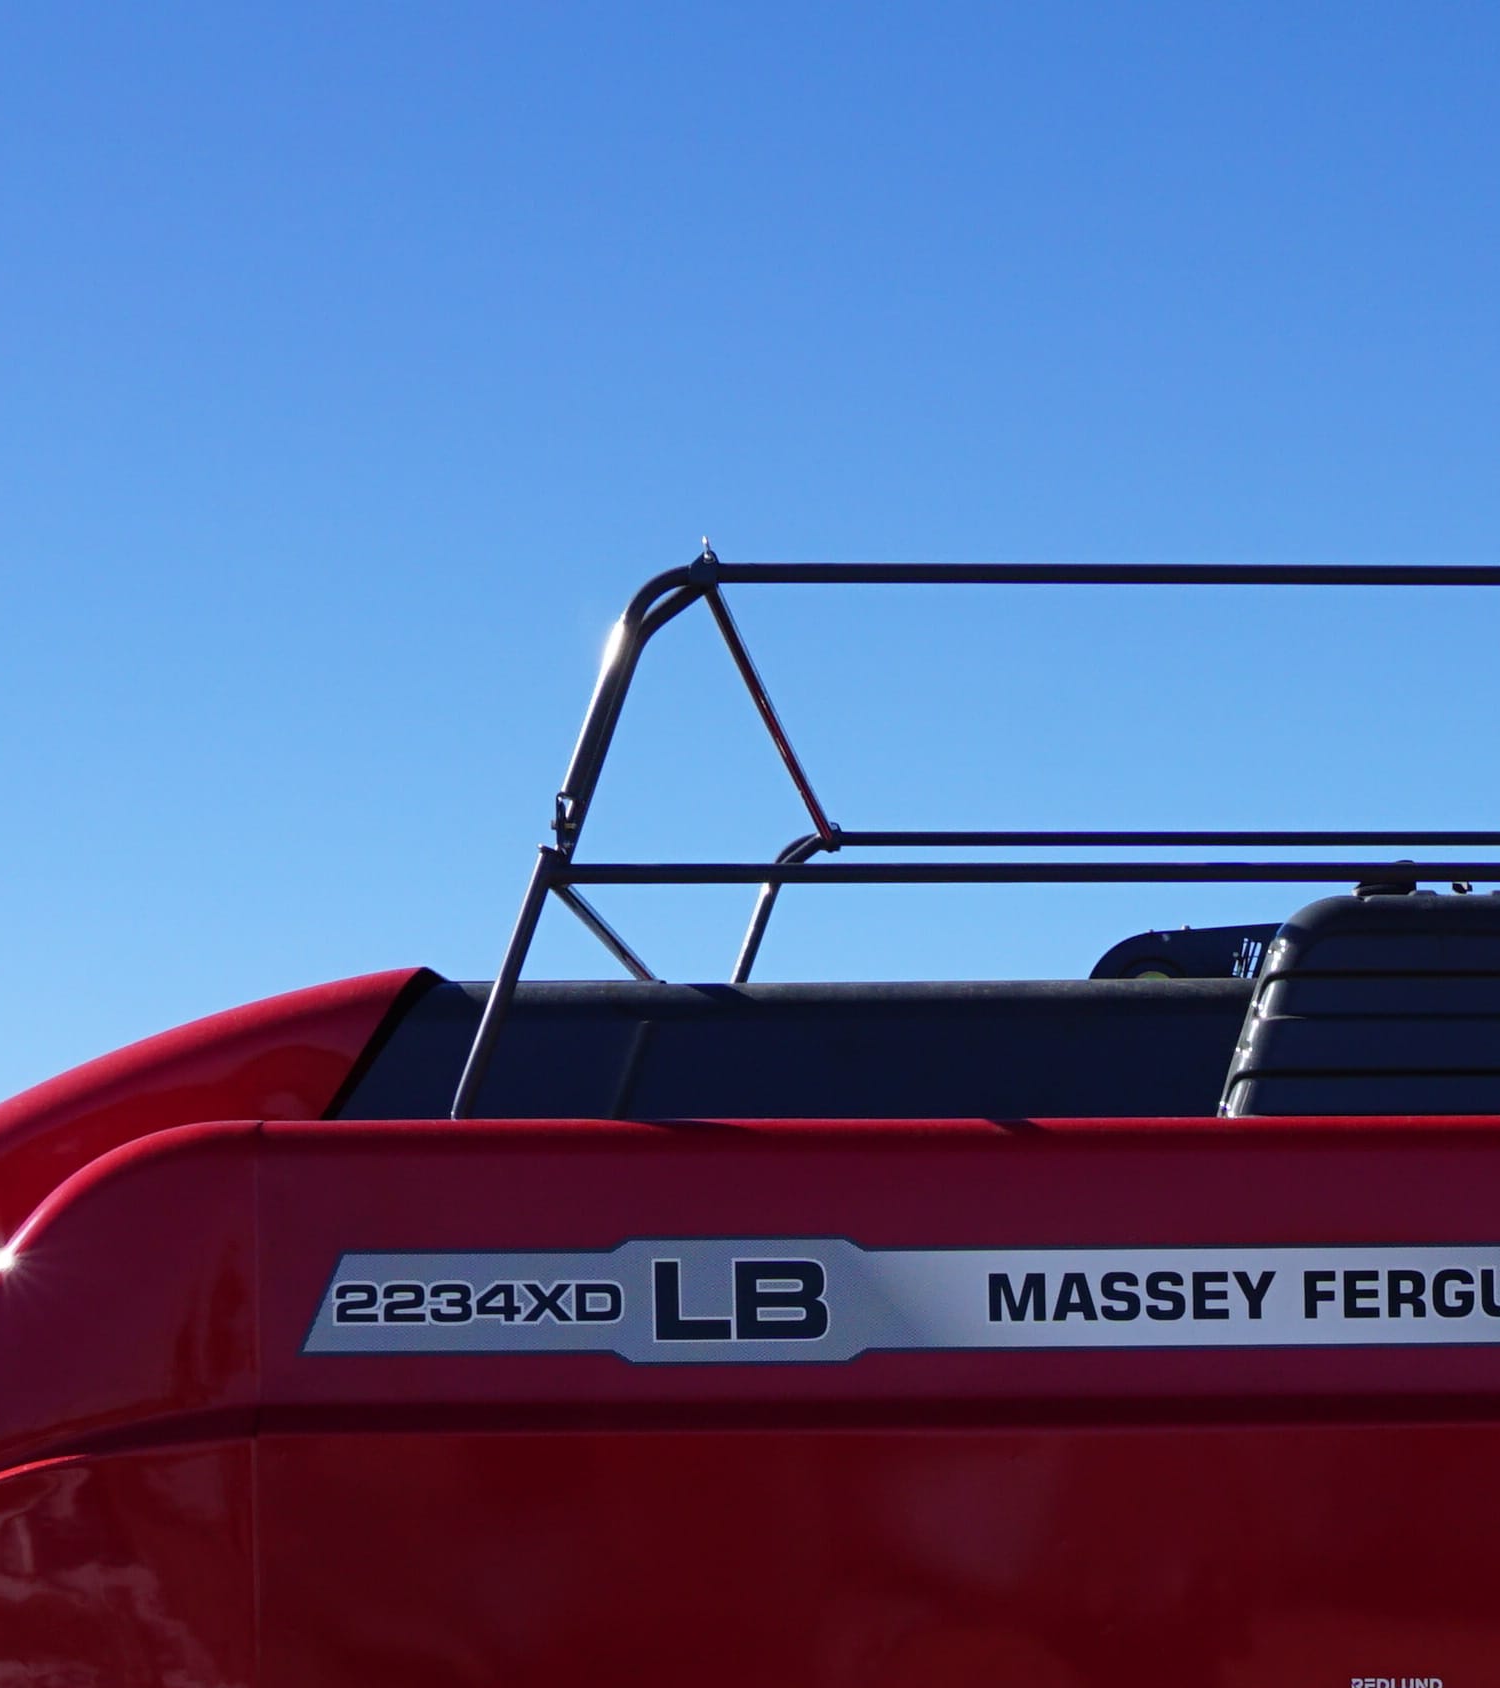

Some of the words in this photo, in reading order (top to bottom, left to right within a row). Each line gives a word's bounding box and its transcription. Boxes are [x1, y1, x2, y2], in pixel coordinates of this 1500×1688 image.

[334, 1281, 625, 1326] 2234XD
[651, 1258, 830, 1342] LB
[987, 1270, 1276, 1323] MASSEY
